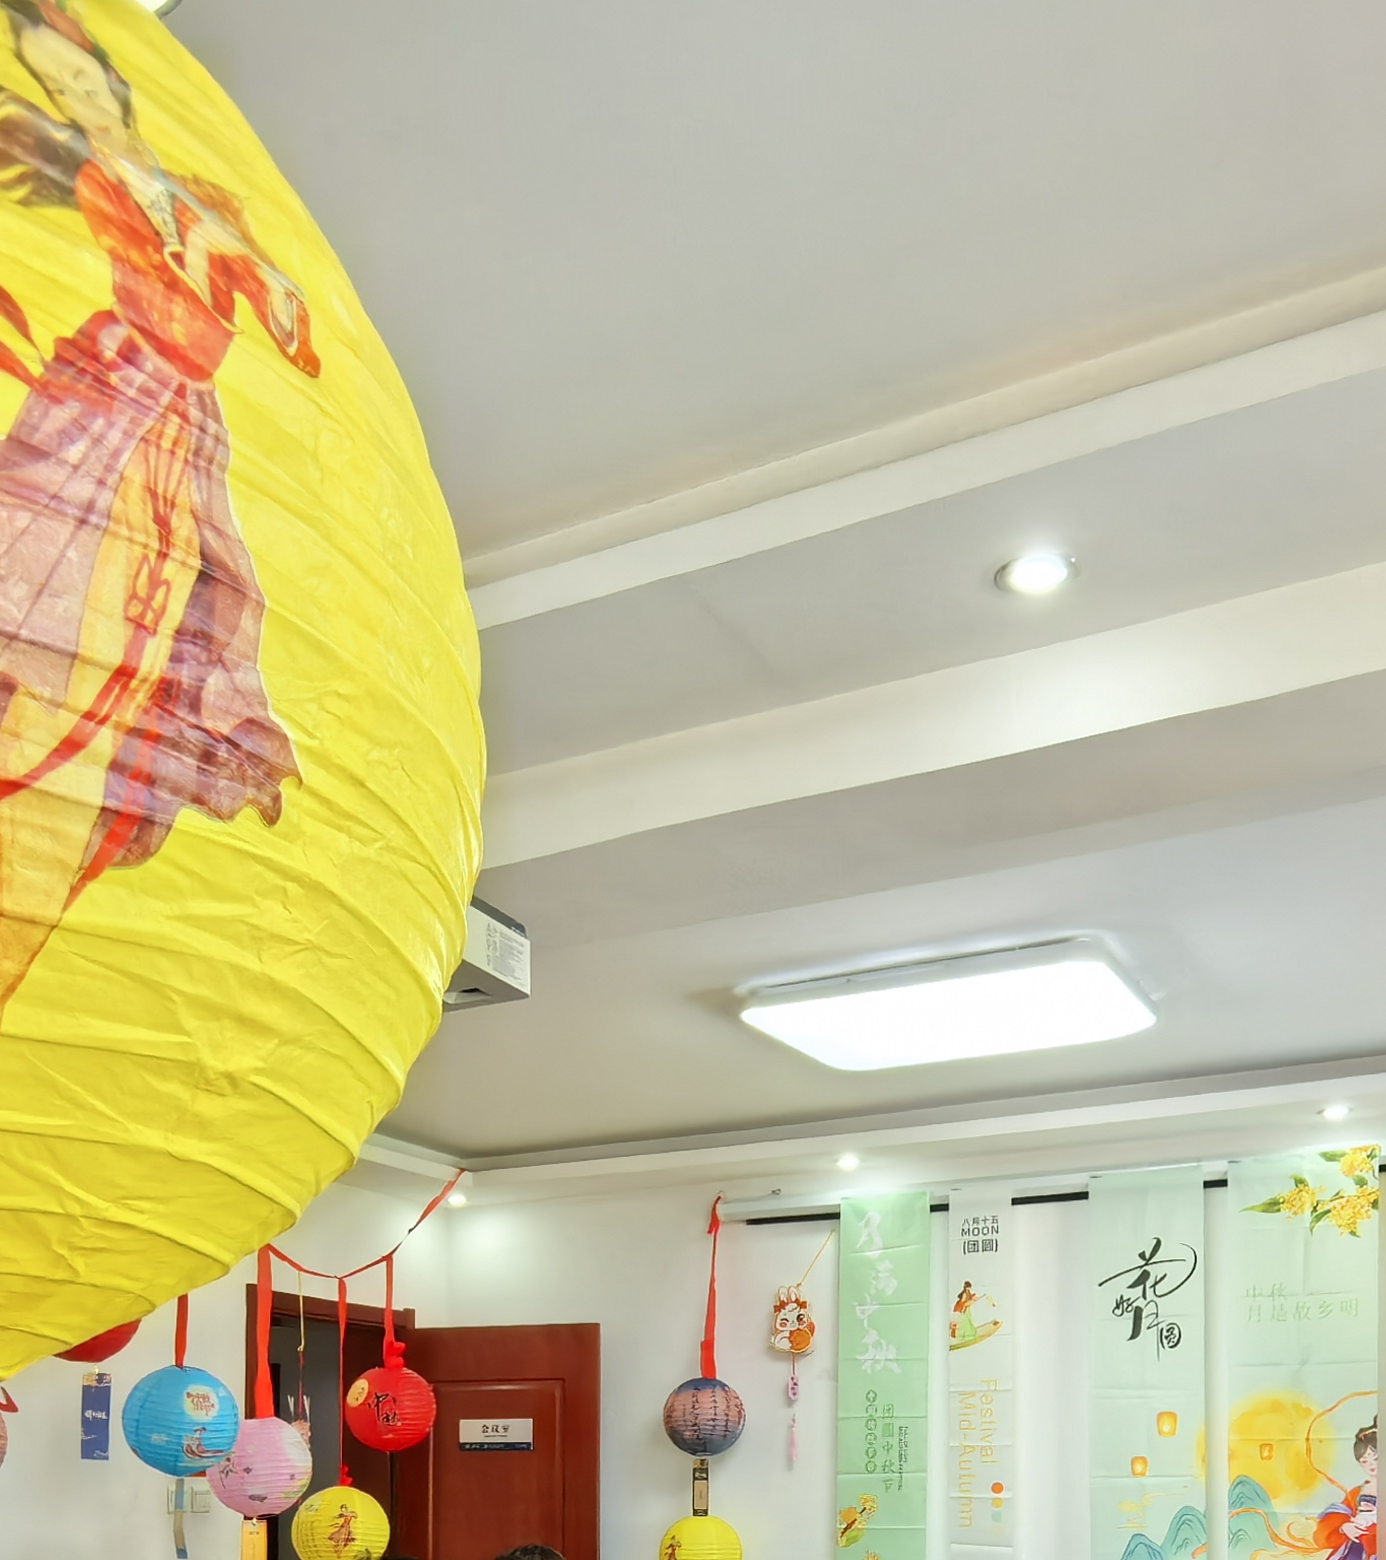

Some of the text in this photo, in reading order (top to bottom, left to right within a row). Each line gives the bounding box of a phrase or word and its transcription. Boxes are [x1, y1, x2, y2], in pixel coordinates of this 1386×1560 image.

[960, 1224, 1000, 1238] MOON
[958, 1391, 978, 1529] Mid-Autumn
[979, 1378, 999, 1465] Festival
